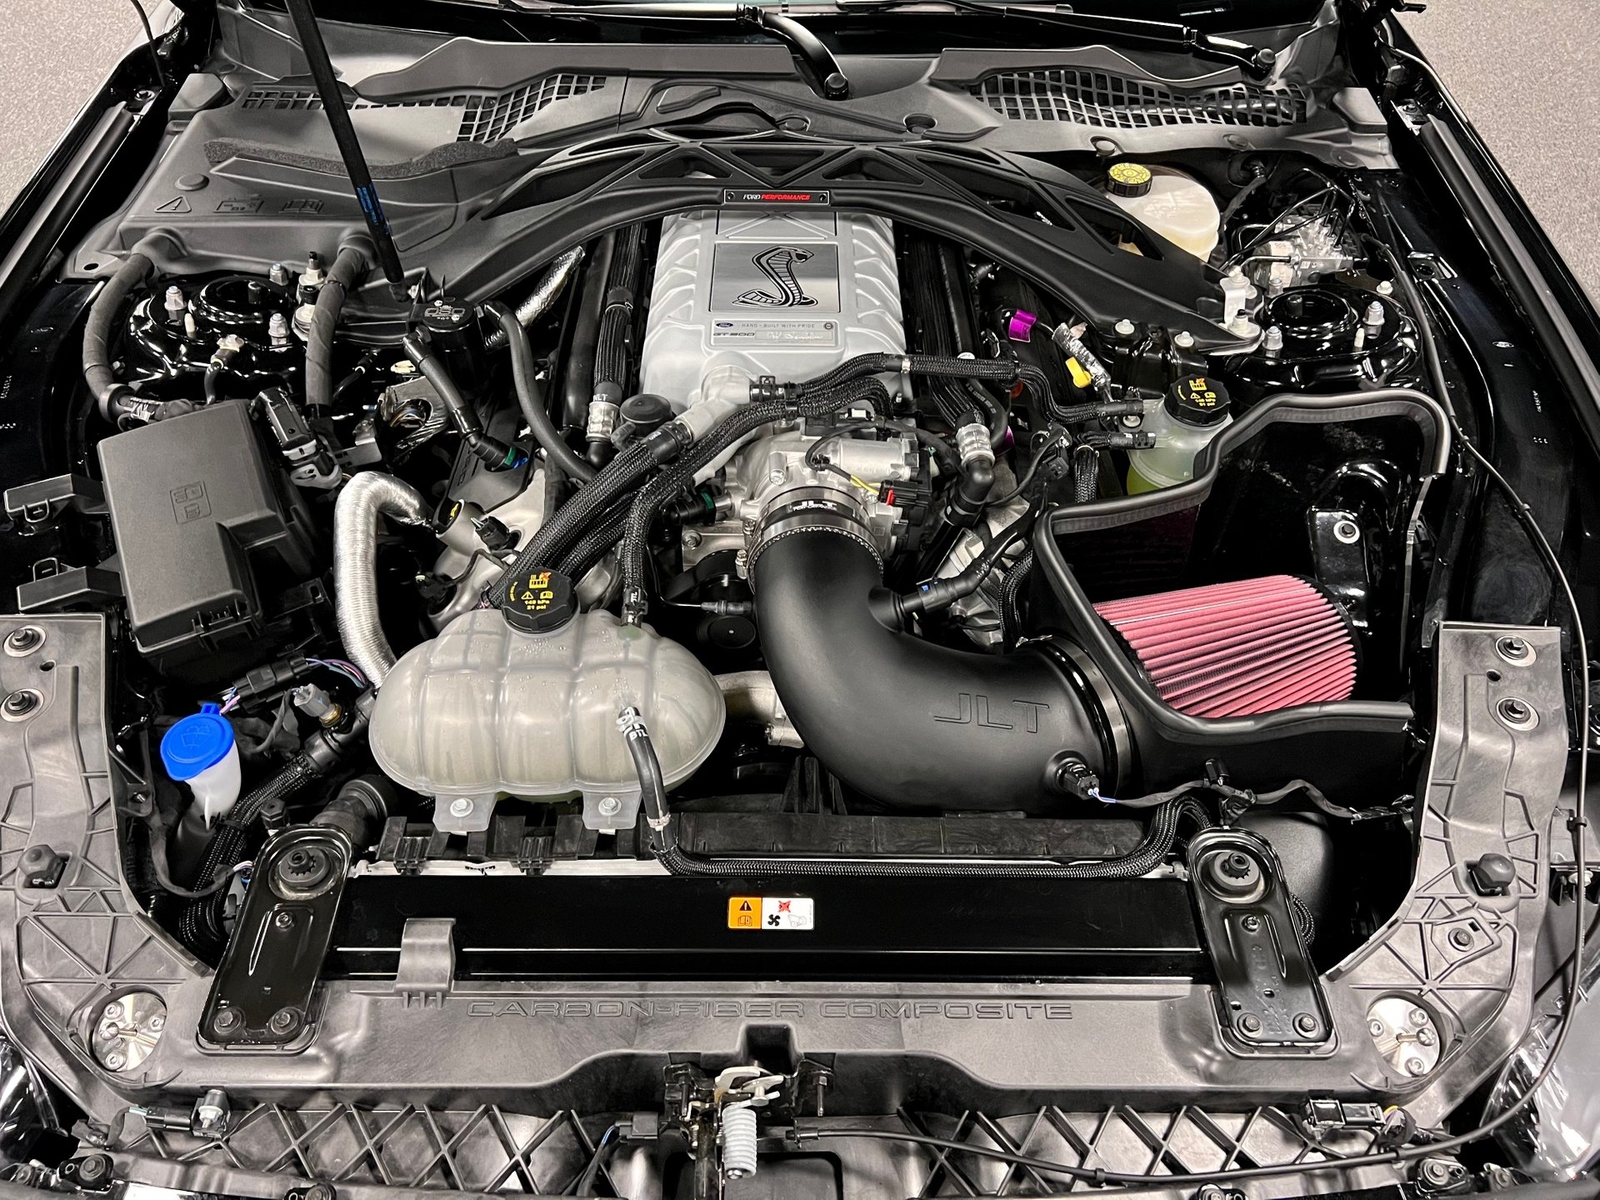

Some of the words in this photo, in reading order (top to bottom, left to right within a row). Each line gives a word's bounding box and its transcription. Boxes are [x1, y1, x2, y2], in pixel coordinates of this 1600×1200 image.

[933, 692, 1051, 734] JLT
[467, 1000, 803, 1018] CARBON-FIBER
[819, 1001, 1073, 1020] COMPOSITE
